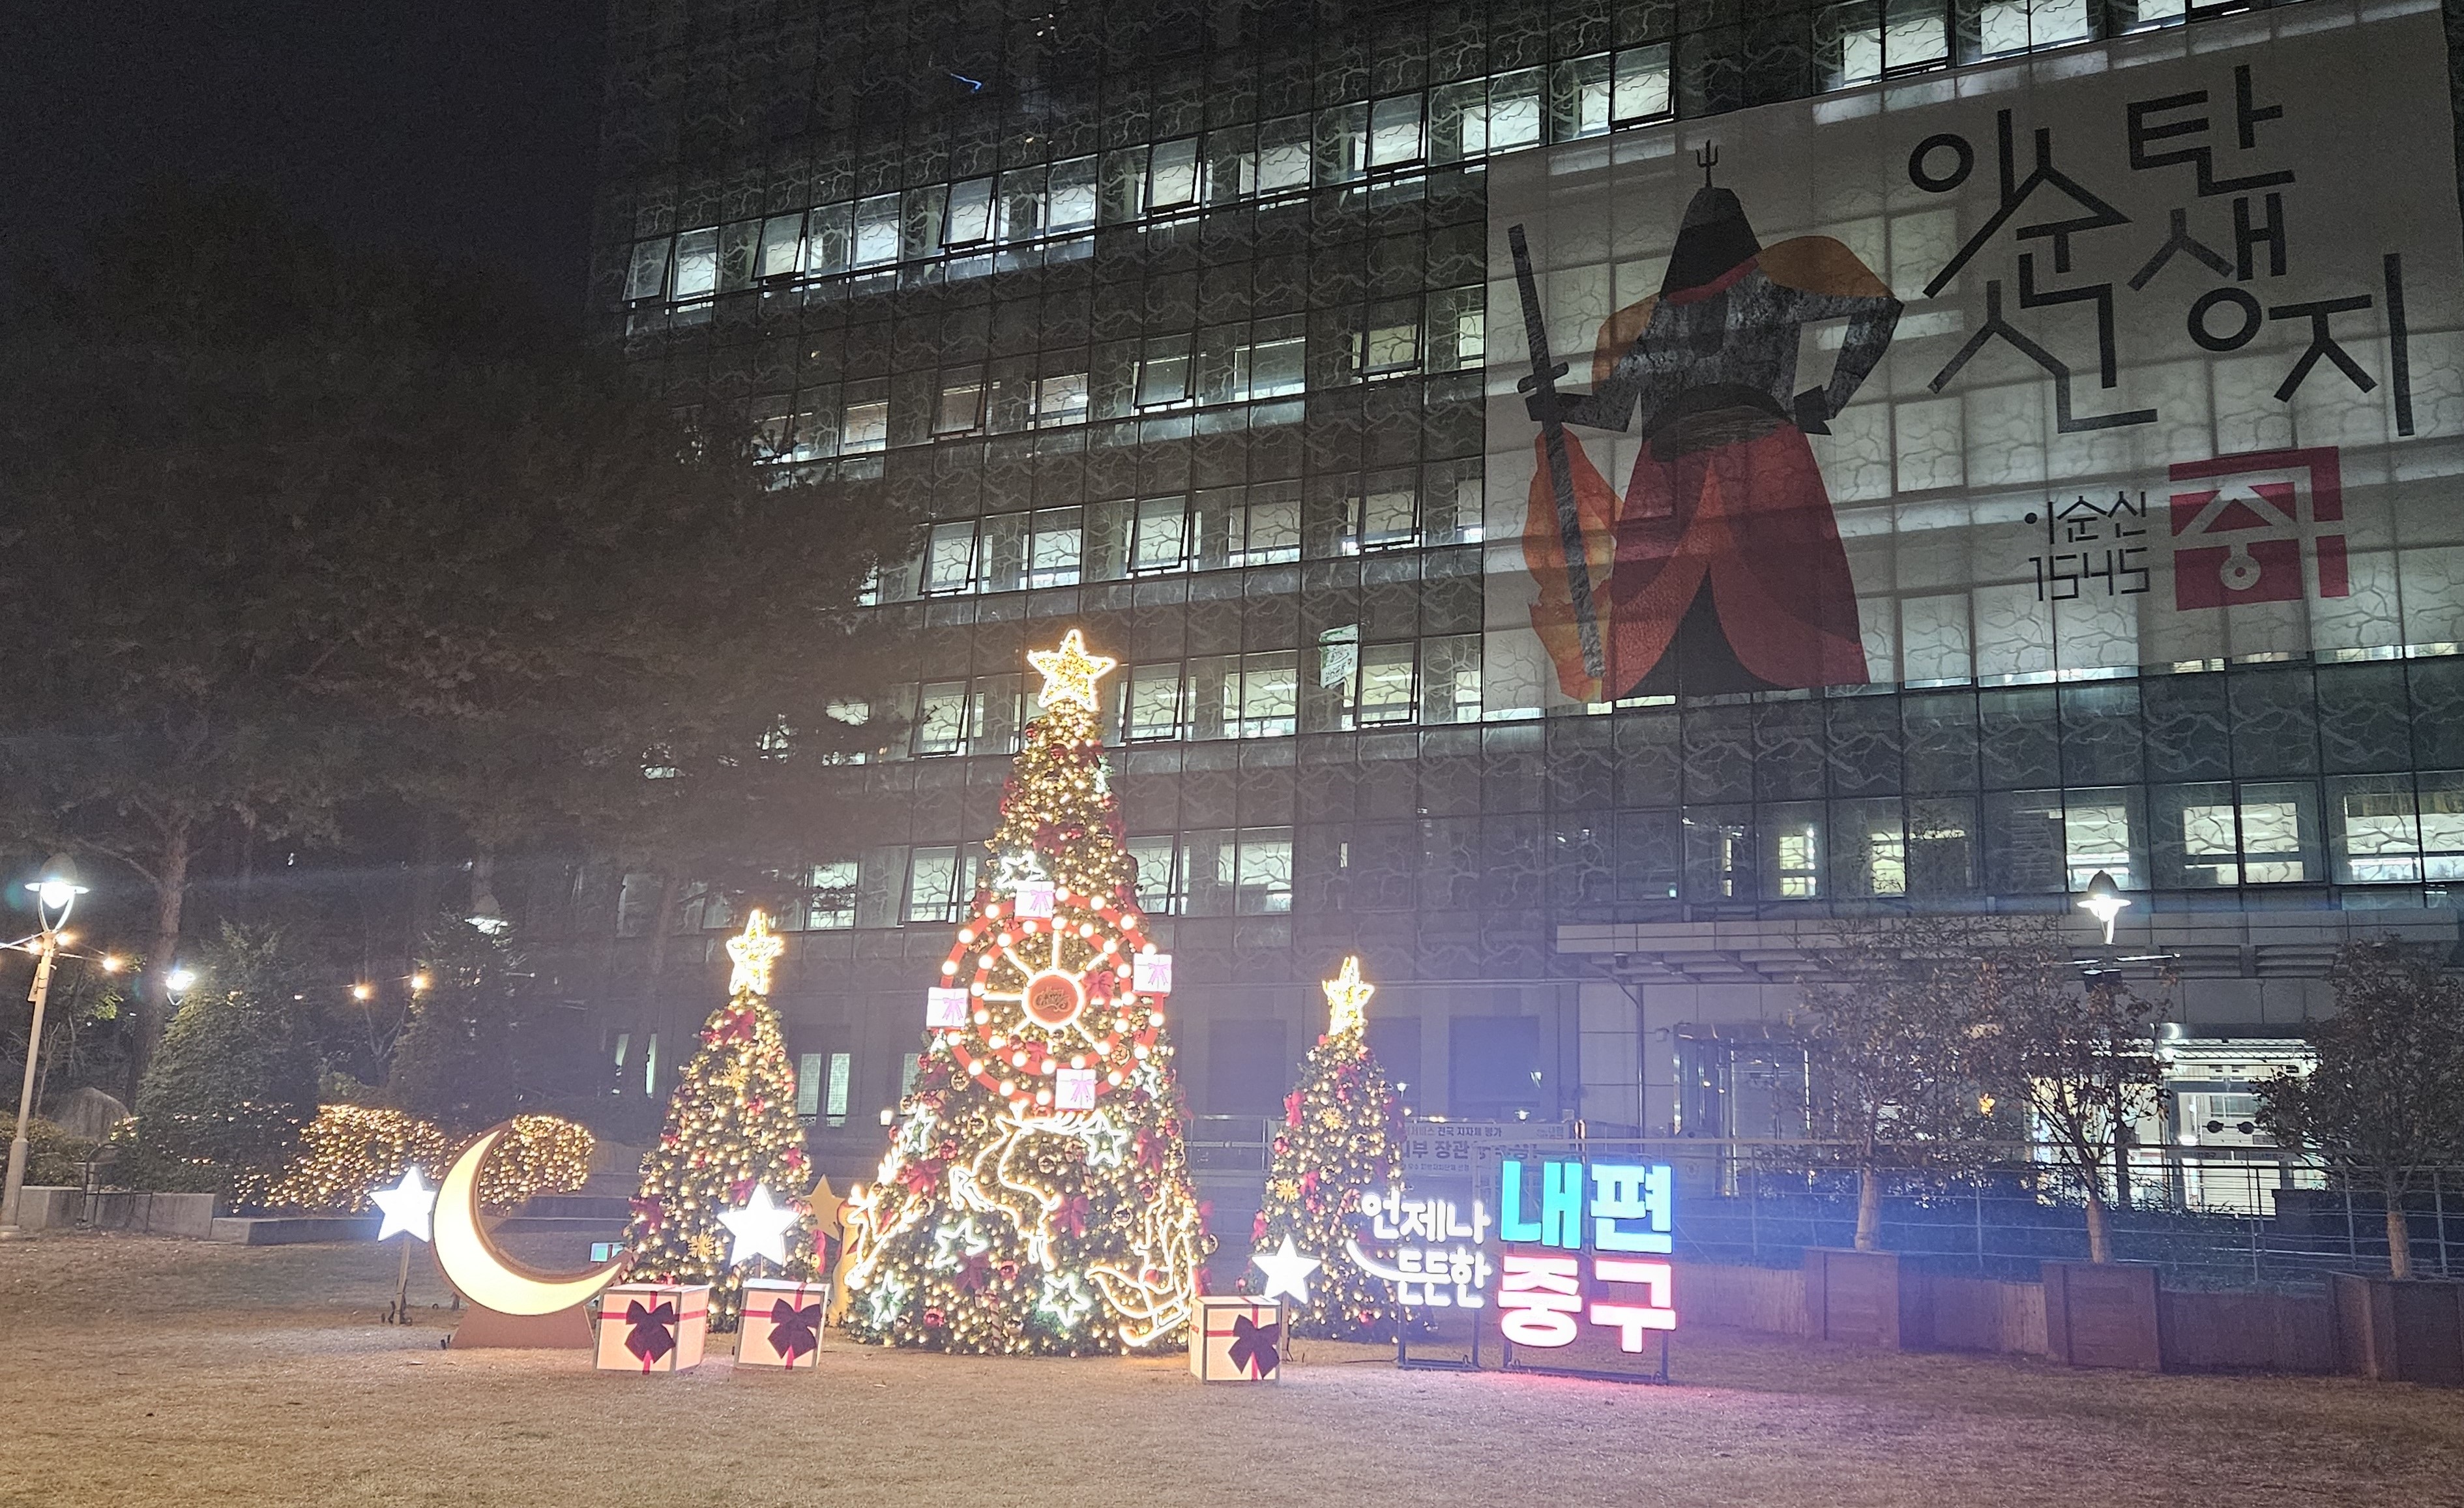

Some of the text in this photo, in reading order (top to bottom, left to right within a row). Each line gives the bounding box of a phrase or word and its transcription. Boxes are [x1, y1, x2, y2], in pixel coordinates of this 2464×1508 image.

[2126, 64, 2414, 437] 탄생지
[2023, 490, 2147, 545] 이순신
[2029, 546, 2150, 602] 1545
[1435, 1140, 1469, 1159] 장관
[1360, 1187, 1492, 1244] 언제나
[1501, 1161, 1672, 1254] 내편
[1499, 1256, 1676, 1353] 중구
